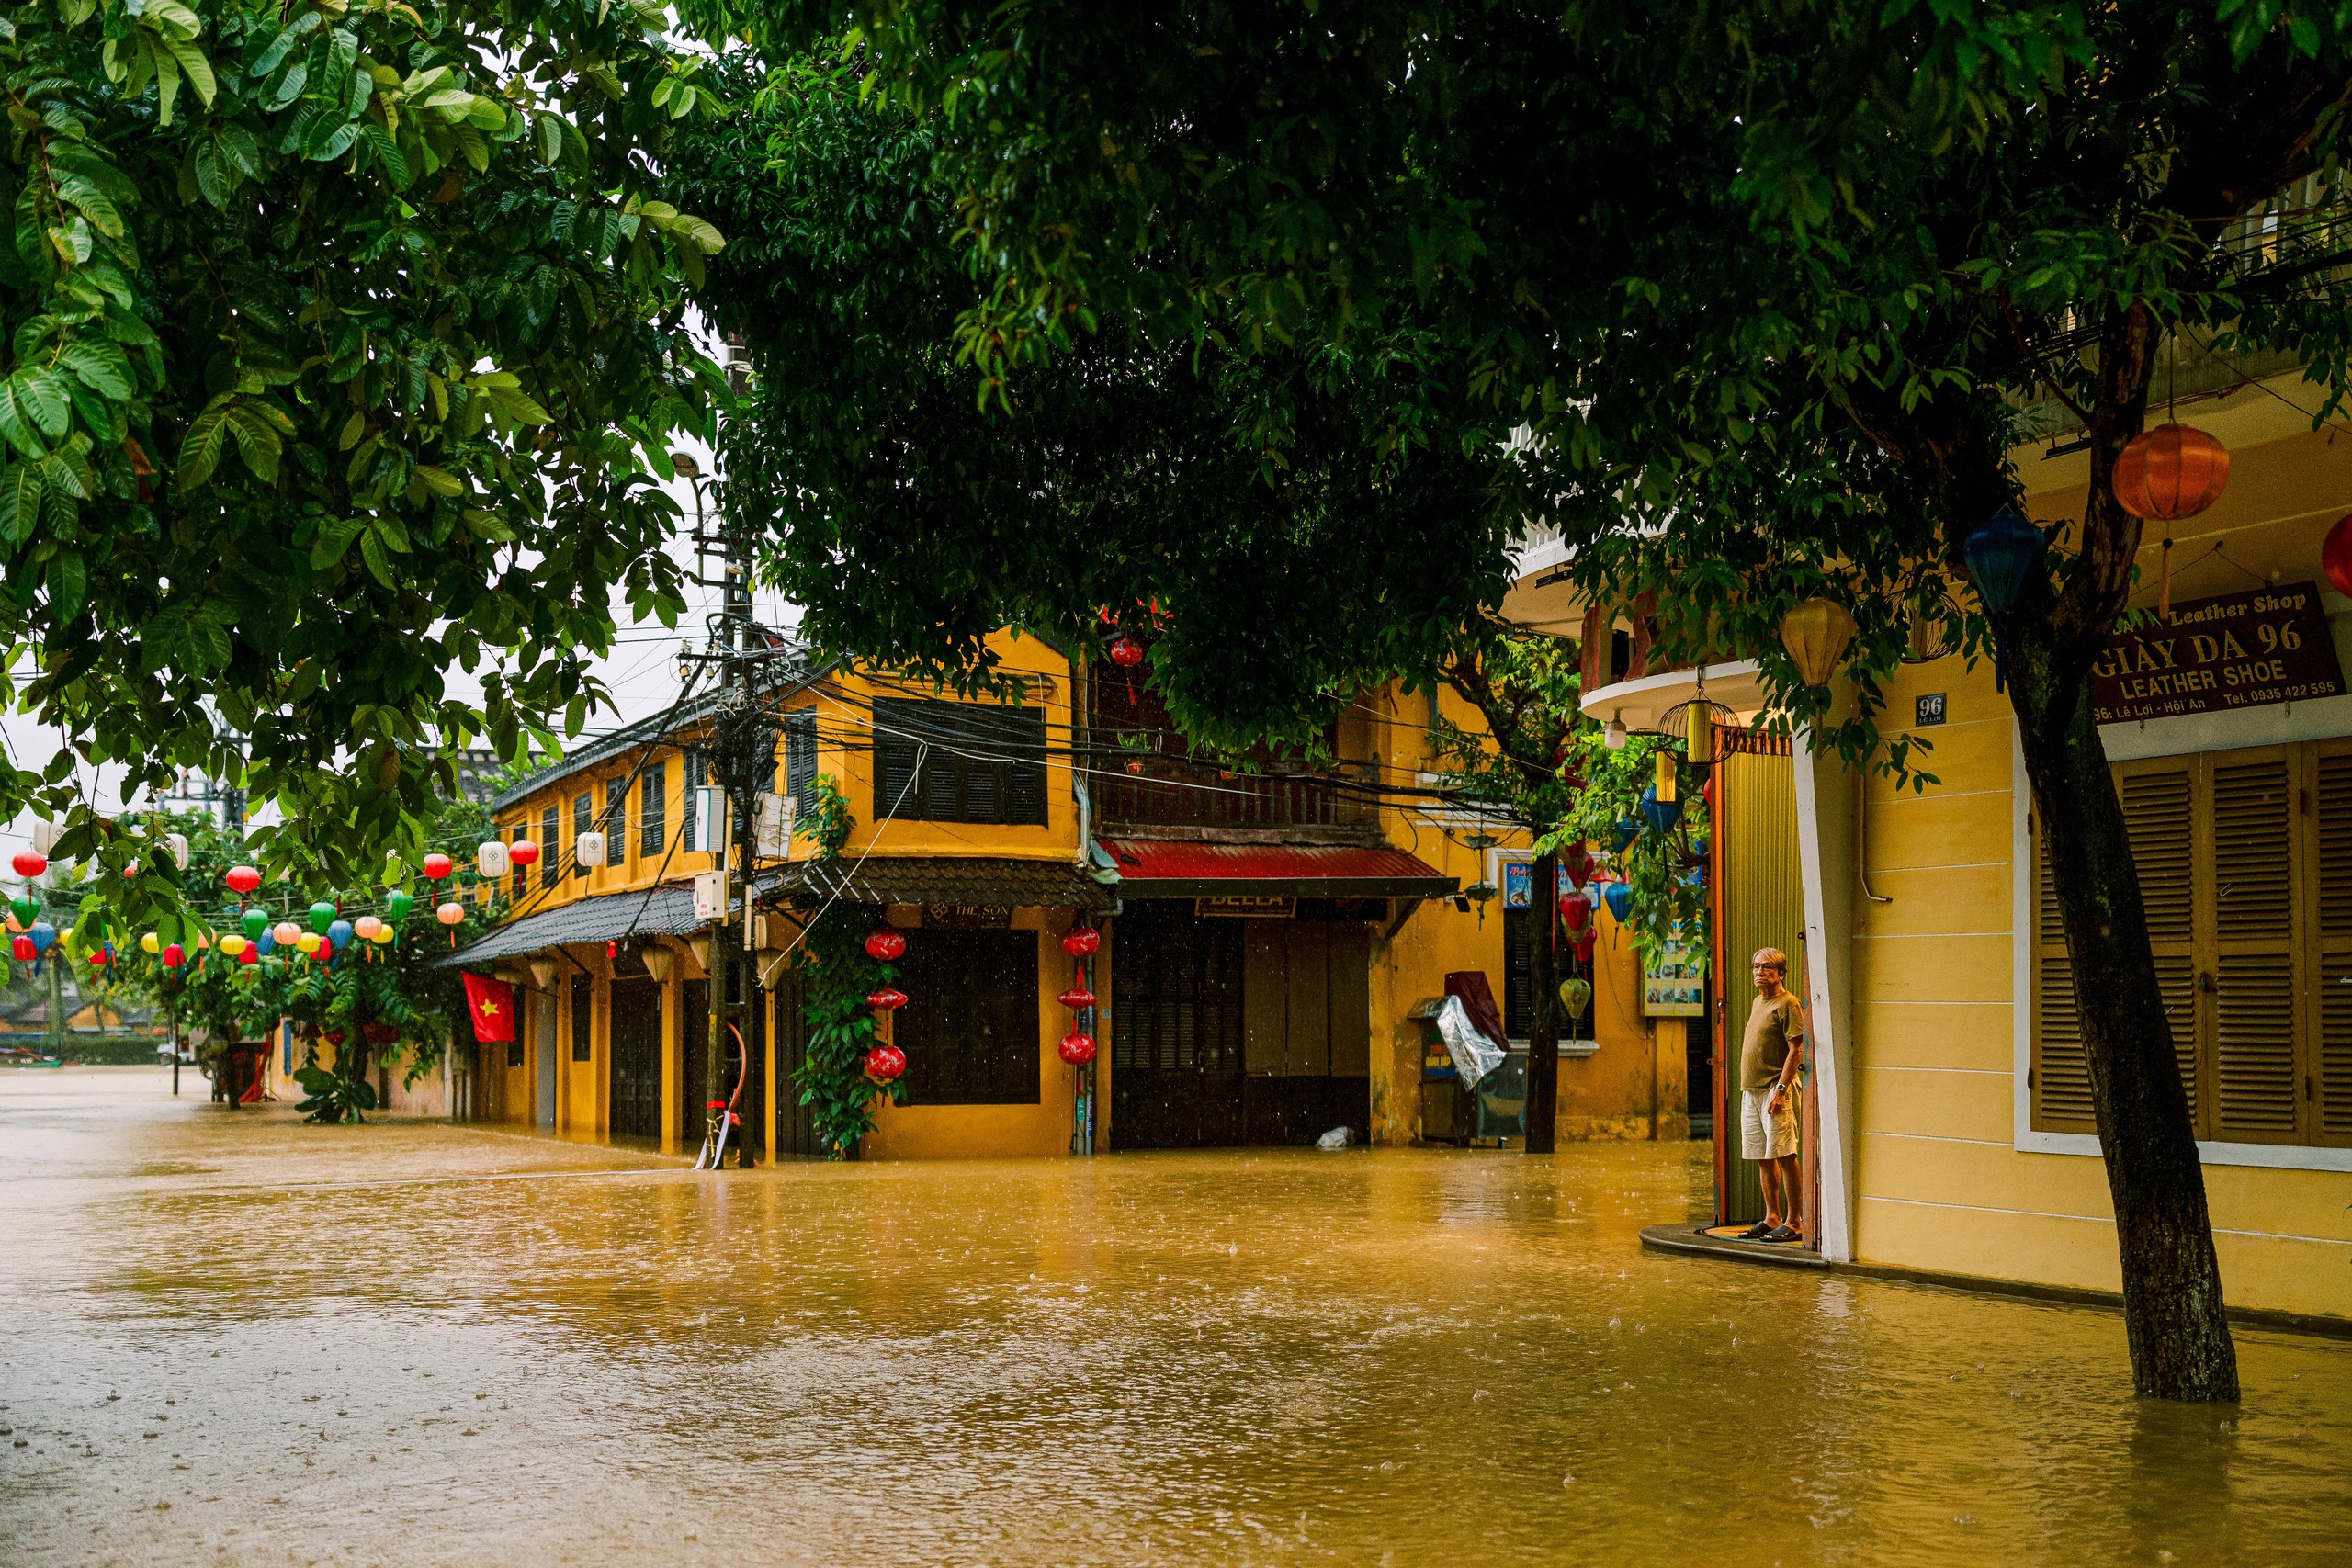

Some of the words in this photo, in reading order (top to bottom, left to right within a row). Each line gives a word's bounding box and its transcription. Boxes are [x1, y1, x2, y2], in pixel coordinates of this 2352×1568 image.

[2169, 603, 2248, 626] Leather
[2254, 593, 2307, 614] Shop
[2091, 636, 2177, 678] GIÀY
[2188, 629, 2249, 663] DA
[2257, 619, 2301, 655] 96
[2120, 669, 2218, 700] LEATHER
[2222, 659, 2287, 687] SHOE
[2222, 692, 2248, 705] Tel:
[2250, 687, 2283, 702] 0935
[2285, 683, 2308, 697] 422
[2310, 681, 2336, 695] 595
[1919, 697, 1942, 716] 96
[2116, 705, 2132, 718] Lê
[2133, 703, 2154, 717] Lợi
[2189, 697, 2207, 710] An
[956, 905, 977, 916] THE
